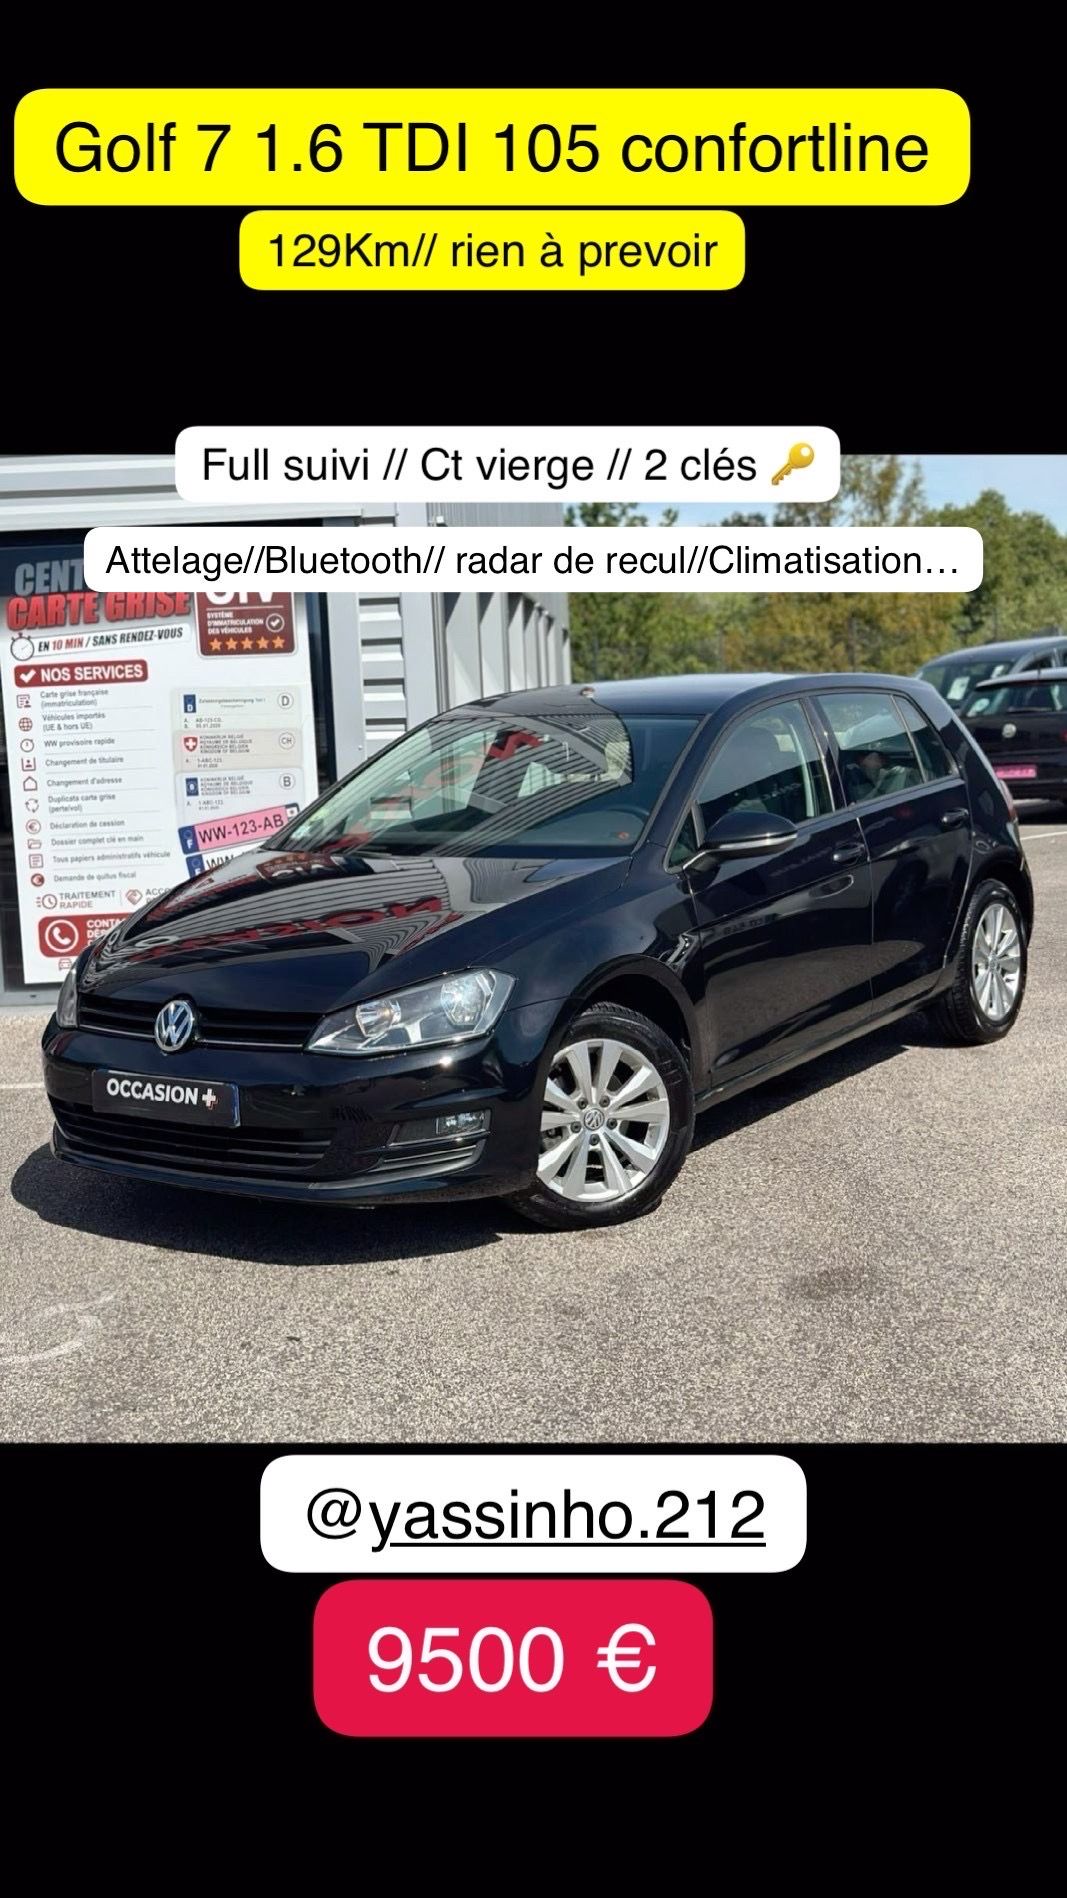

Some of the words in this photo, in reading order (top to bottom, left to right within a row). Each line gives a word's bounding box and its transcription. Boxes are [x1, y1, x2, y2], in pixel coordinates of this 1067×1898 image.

[15, 559, 84, 596] CENT
[7, 593, 99, 630] CARTE
[105, 592, 191, 622] GRISE
[38, 641, 49, 652] EN
[52, 640, 63, 651] 10
[65, 639, 84, 650] MIN
[85, 637, 91, 647] /
[92, 636, 117, 647] SANS
[120, 628, 183, 643] RENDEZ-VOUS
[41, 668, 71, 682] NOS
[74, 664, 143, 681] SERVICES
[40, 690, 58, 698] Carte
[60, 689, 76, 699] grise
[78, 688, 109, 697] française
[41, 699, 97, 708] (immatriculation)
[281, 695, 290, 706] D
[42, 713, 74, 722] Véhicules
[76, 712, 106, 721] importés
[44, 740, 57, 748] WW
[59, 738, 92, 748] provisoire
[94, 737, 115, 747] rapide
[45, 758, 87, 768] Changement
[98, 756, 124, 764] titulaire
[47, 779, 88, 789] Changement
[90, 776, 122, 785] d'adresse
[283, 776, 291, 787] B
[48, 794, 79, 804] Duplicata
[99, 792, 116, 801] grise
[50, 820, 87, 830] Déclaration
[99, 819, 125, 827] cession
[198, 814, 284, 843] WW-123-AB
[51, 838, 76, 846] Dossier
[78, 837, 105, 845] complet
[128, 834, 144, 842] main
[187, 840, 193, 849] F
[53, 855, 68, 863] Tous
[71, 854, 94, 863] papiers
[97, 852, 141, 861] administratifs
[143, 850, 170, 858] véhicule
[54, 874, 85, 883] Demande
[119, 871, 136, 879] fiscal
[59, 890, 116, 900] TRAITEMENT
[59, 900, 93, 909] RAPIDE
[107, 1077, 199, 1105] OCCASION
